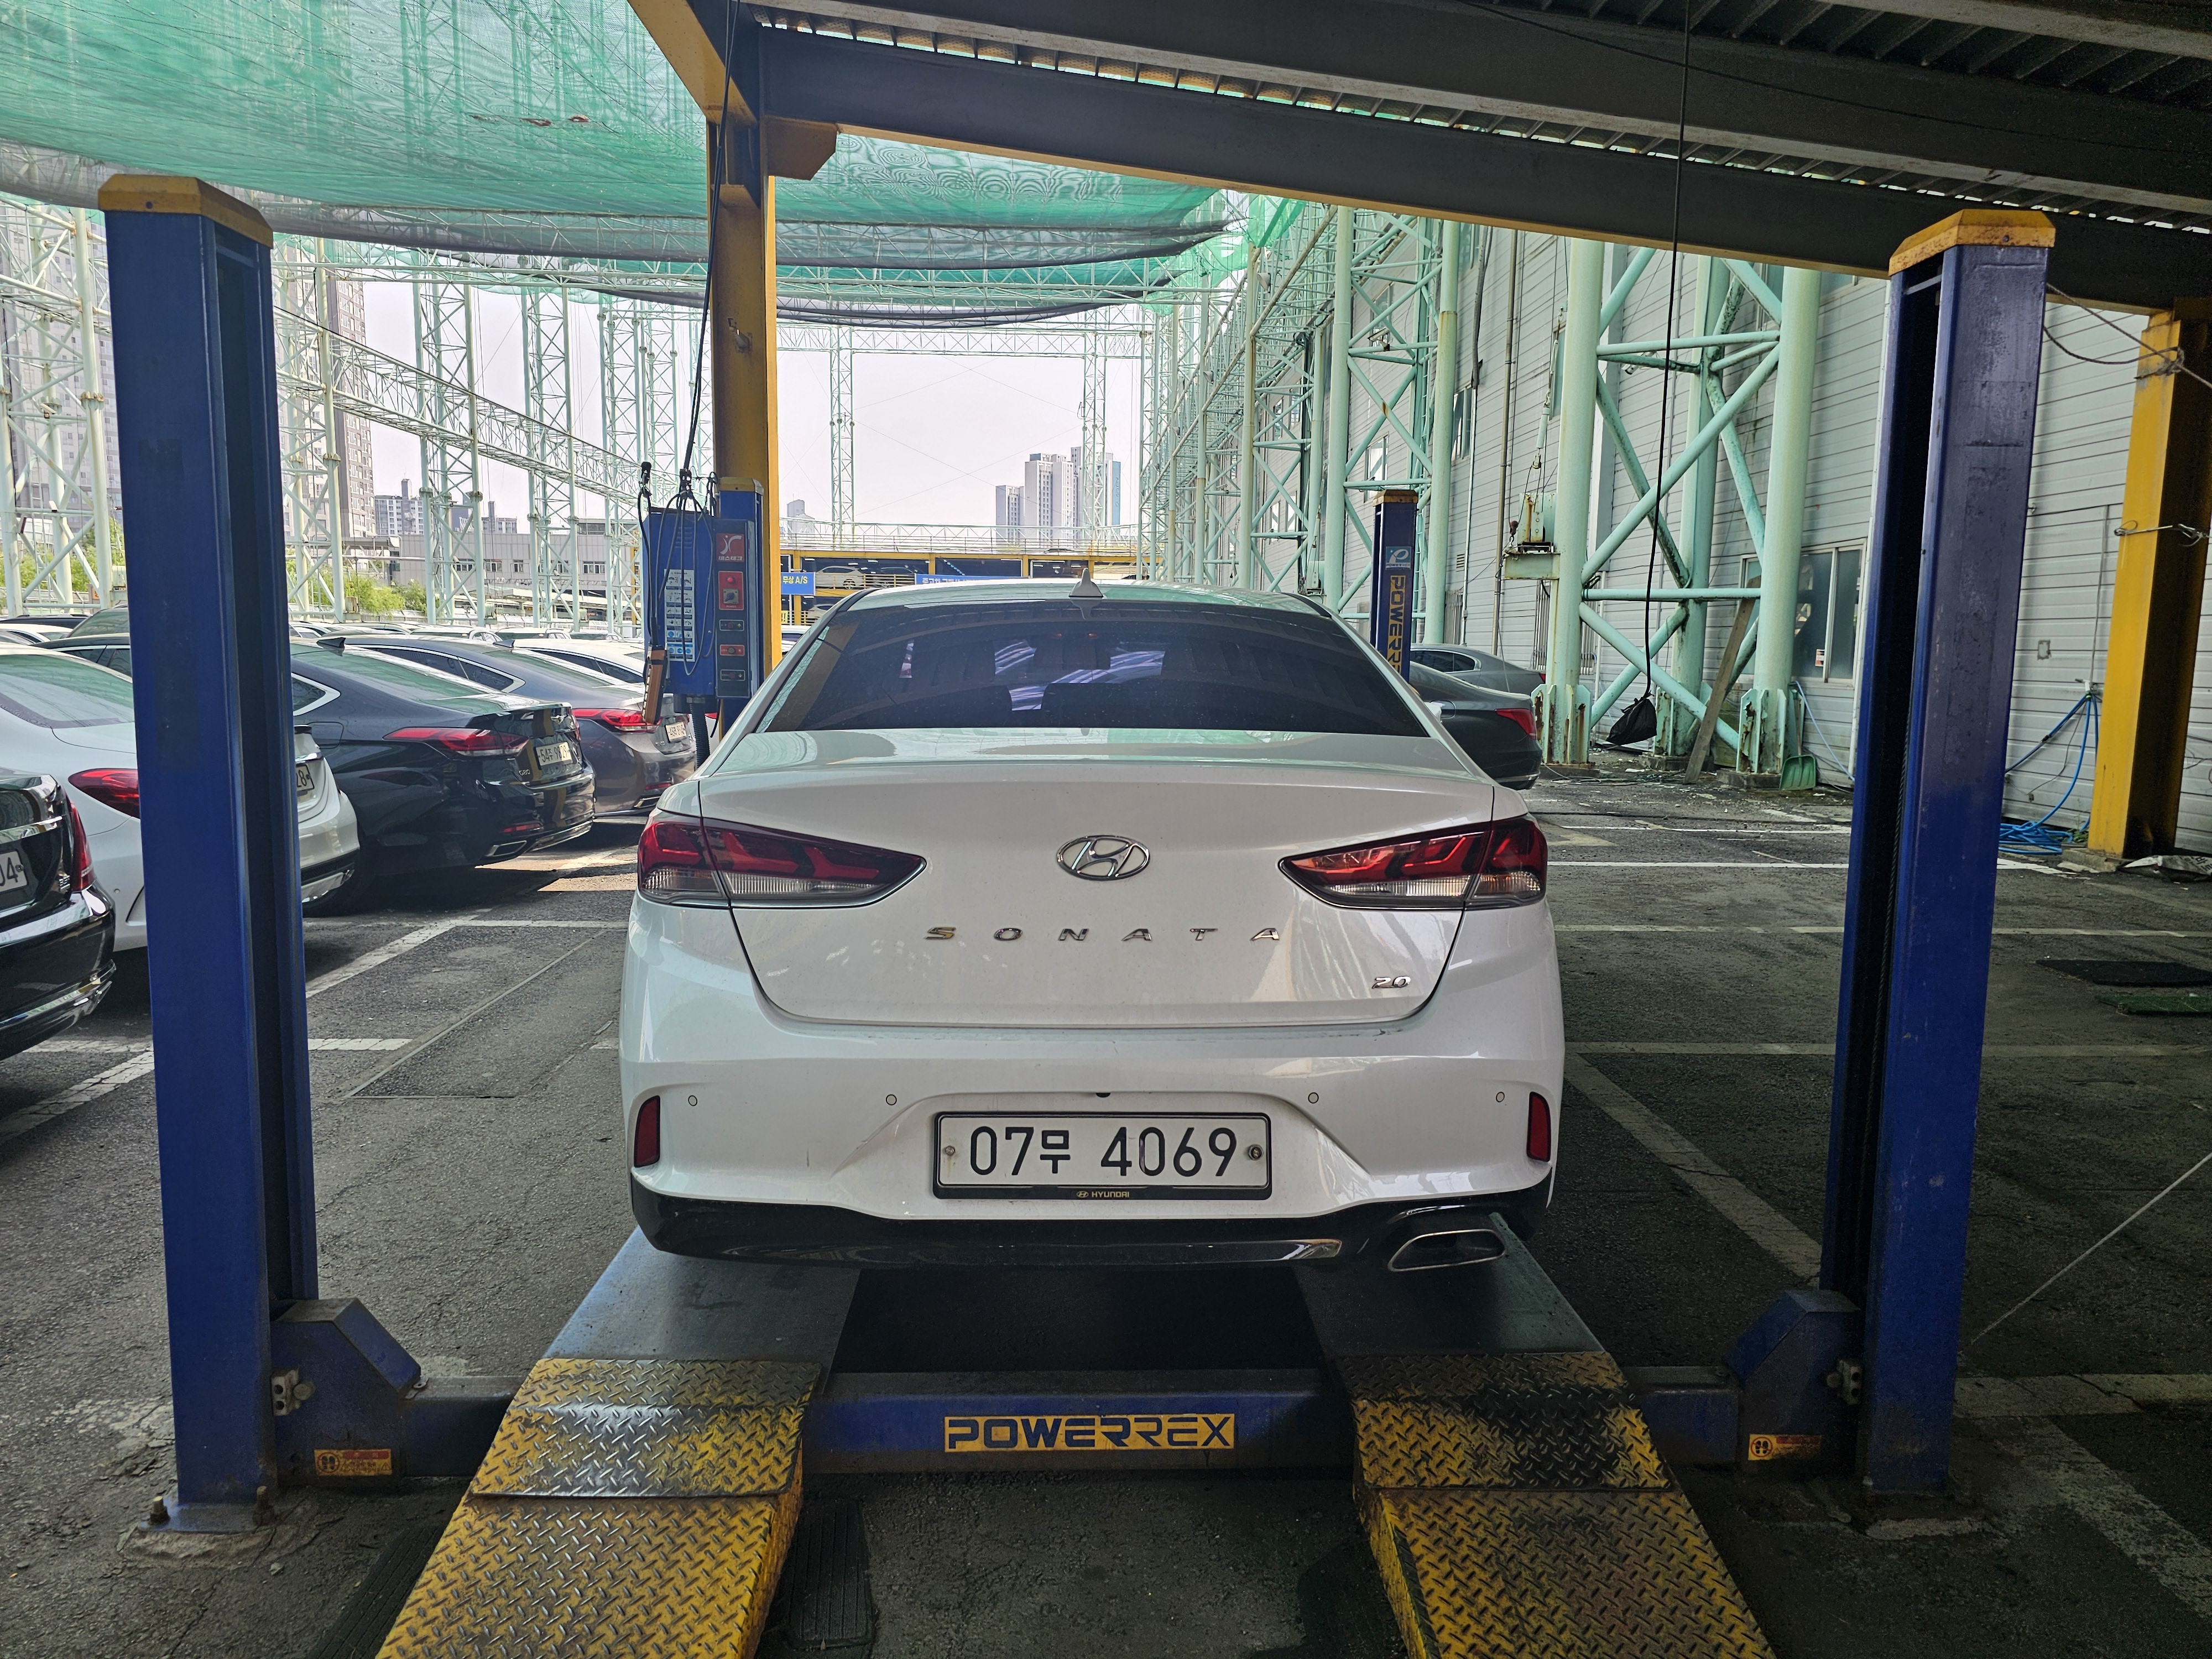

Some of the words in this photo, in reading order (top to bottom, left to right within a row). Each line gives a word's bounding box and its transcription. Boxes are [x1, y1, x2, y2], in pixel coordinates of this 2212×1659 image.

[782, 576, 794, 584] 무상
[795, 576, 808, 584] A/S
[924, 927, 1280, 941] SONATA
[970, 1126, 1071, 1176] 07무
[1100, 1126, 1237, 1177] 4069
[948, 1416, 1232, 1449] POWERREX
